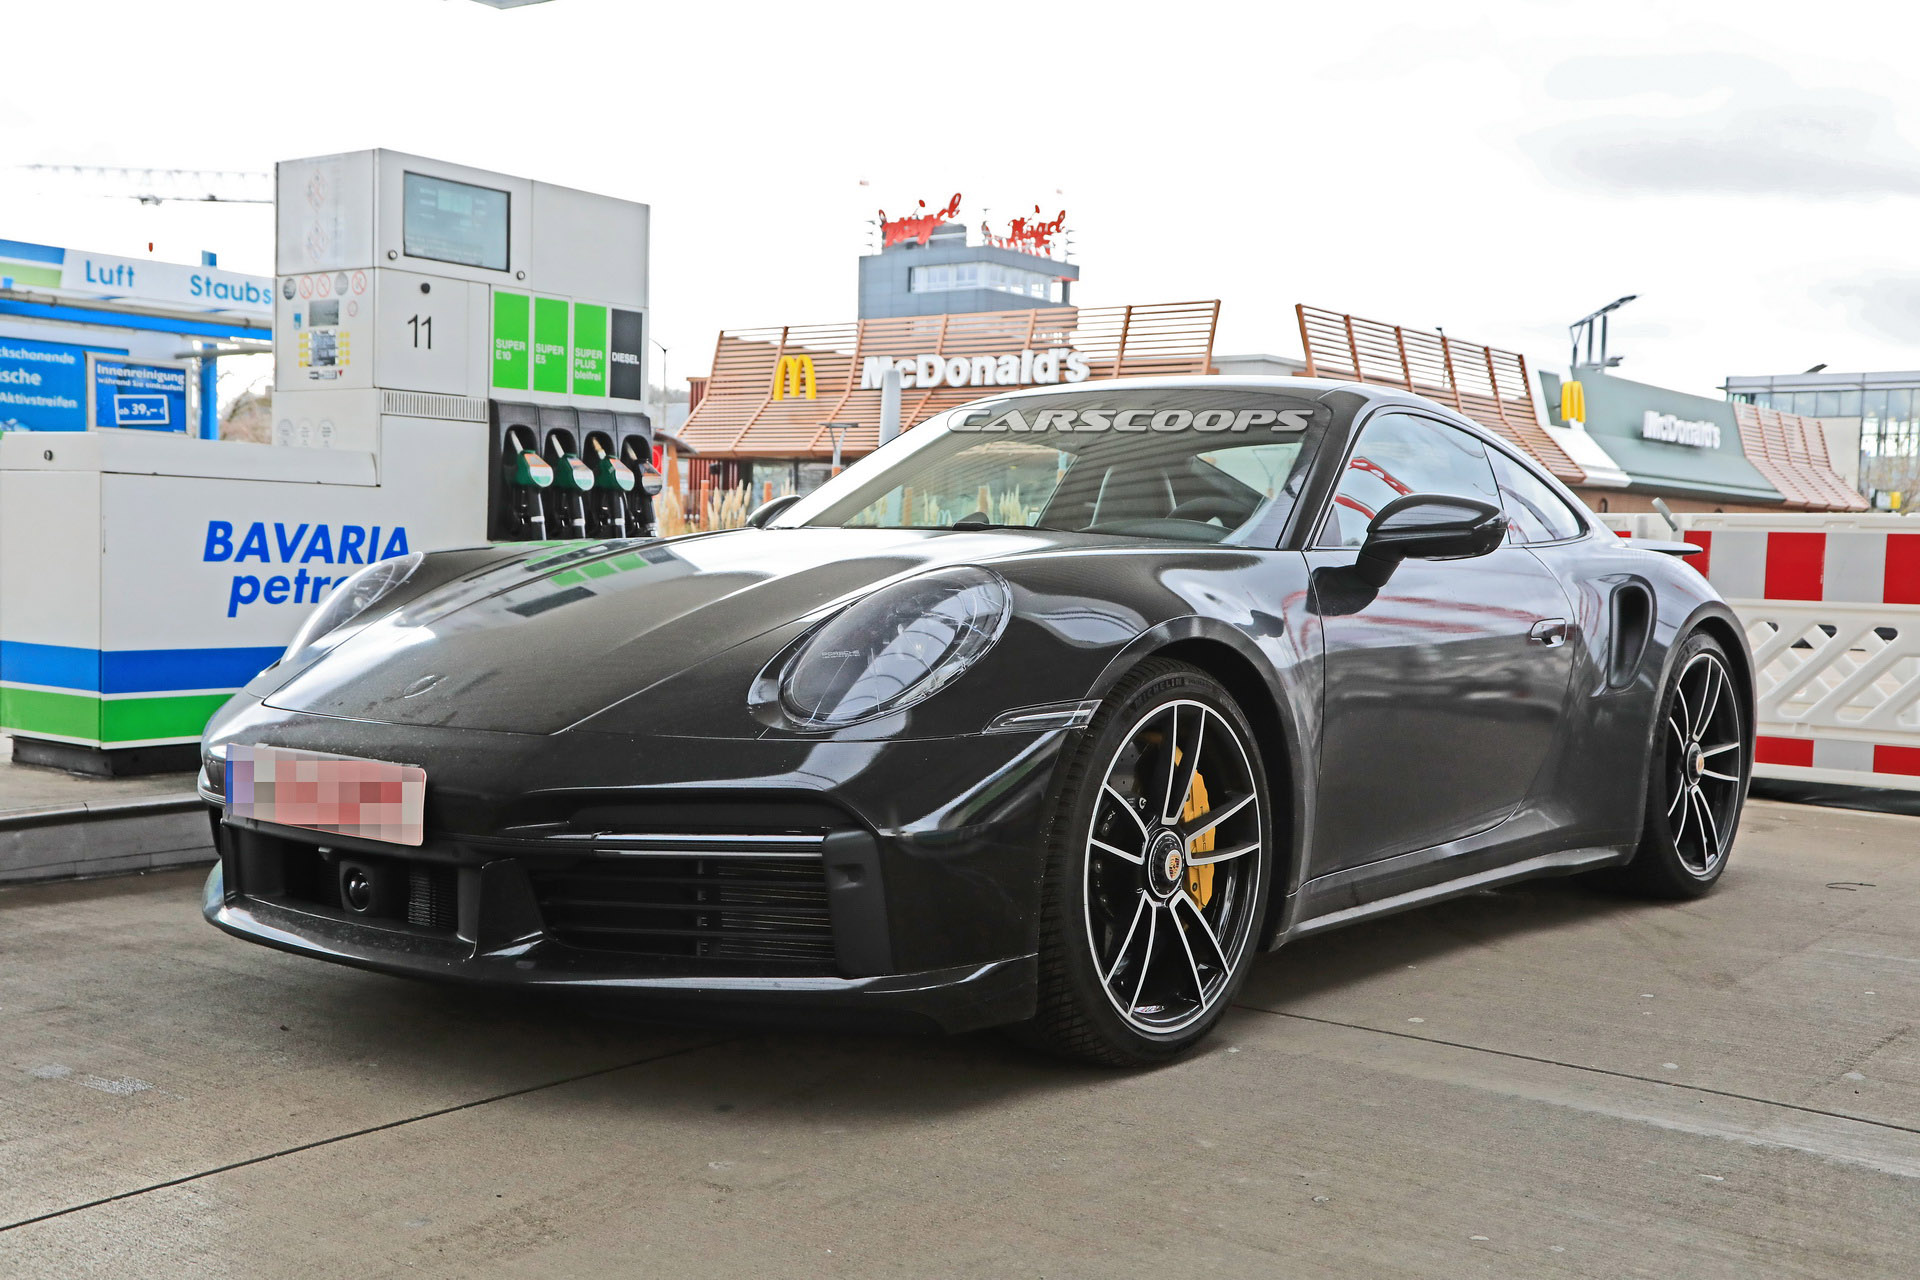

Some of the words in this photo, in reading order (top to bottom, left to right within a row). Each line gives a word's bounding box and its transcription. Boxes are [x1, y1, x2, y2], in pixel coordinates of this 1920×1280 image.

[85, 260, 135, 288] Luft
[190, 274, 272, 305] Staubs
[407, 314, 432, 350] 11
[495, 338, 526, 351] SUPER
[535, 343, 564, 356] SUPER
[495, 350, 512, 361] E10
[535, 354, 546, 365] E5
[574, 347, 603, 360] SUPER
[611, 351, 640, 365] DIESEL
[574, 358, 597, 370] PLUS
[860, 347, 1091, 389] McDonald's
[97, 363, 185, 386] Innenreinigung
[574, 369, 602, 382] bleifrei
[1643, 410, 1721, 450] McDonald's
[203, 520, 410, 565] BAVARIA
